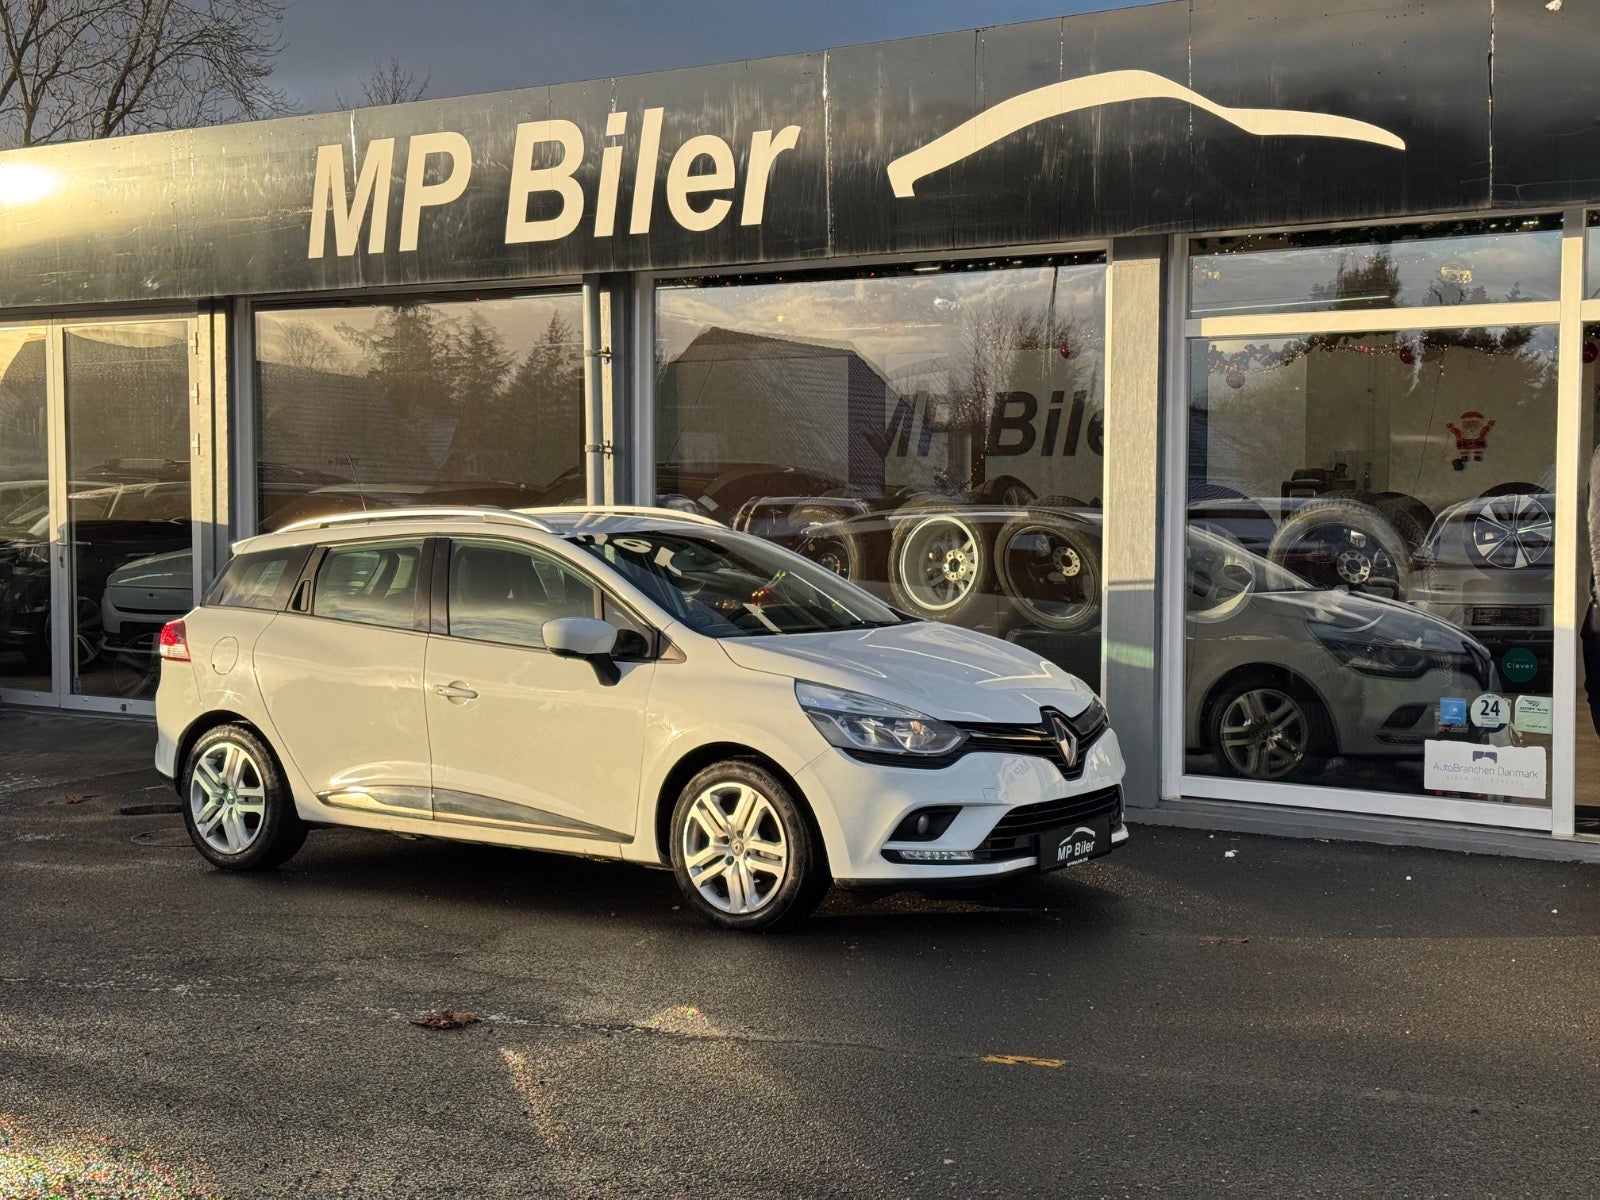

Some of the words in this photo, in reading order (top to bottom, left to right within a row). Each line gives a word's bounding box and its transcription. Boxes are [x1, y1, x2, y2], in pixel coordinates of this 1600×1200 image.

[308, 131, 473, 259] MP
[504, 107, 801, 243] Biler
[1480, 699, 1501, 717] 24
[1433, 762, 1495, 775] AutoBranchen
[1497, 767, 1538, 779] Danmark
[1057, 844, 1073, 861] MP
[1074, 839, 1095, 857] Biler
